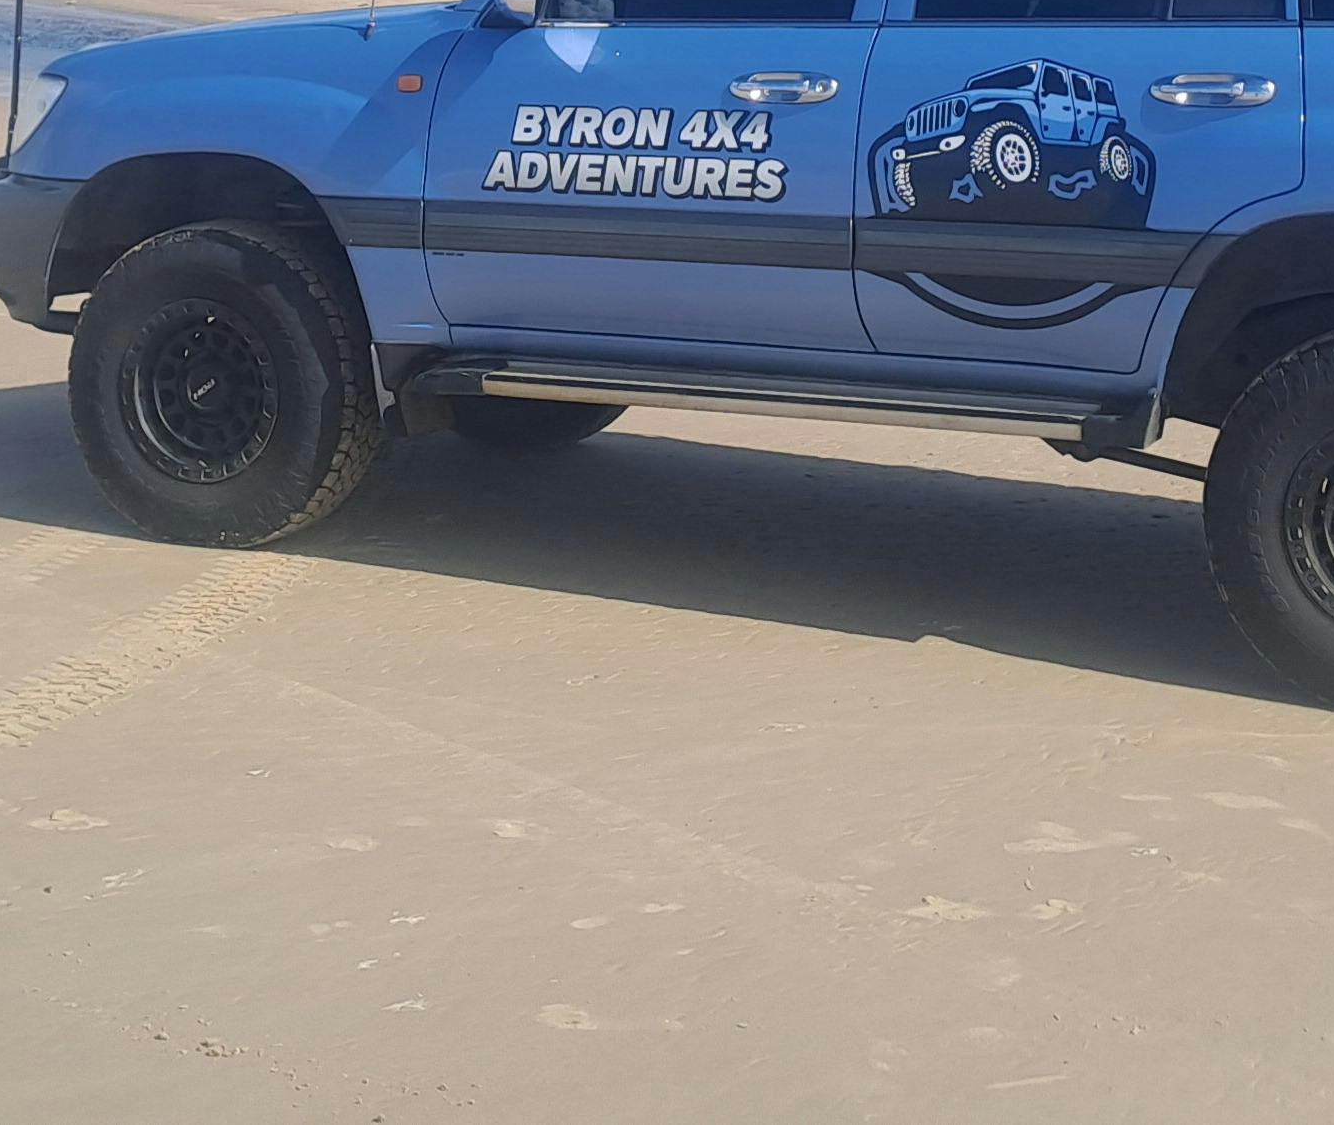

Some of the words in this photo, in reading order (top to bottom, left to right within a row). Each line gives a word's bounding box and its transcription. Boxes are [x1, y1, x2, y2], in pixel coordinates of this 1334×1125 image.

[512, 105, 672, 149] BYRON
[679, 110, 771, 152] 4X4
[482, 150, 788, 201] ADVENTURES
